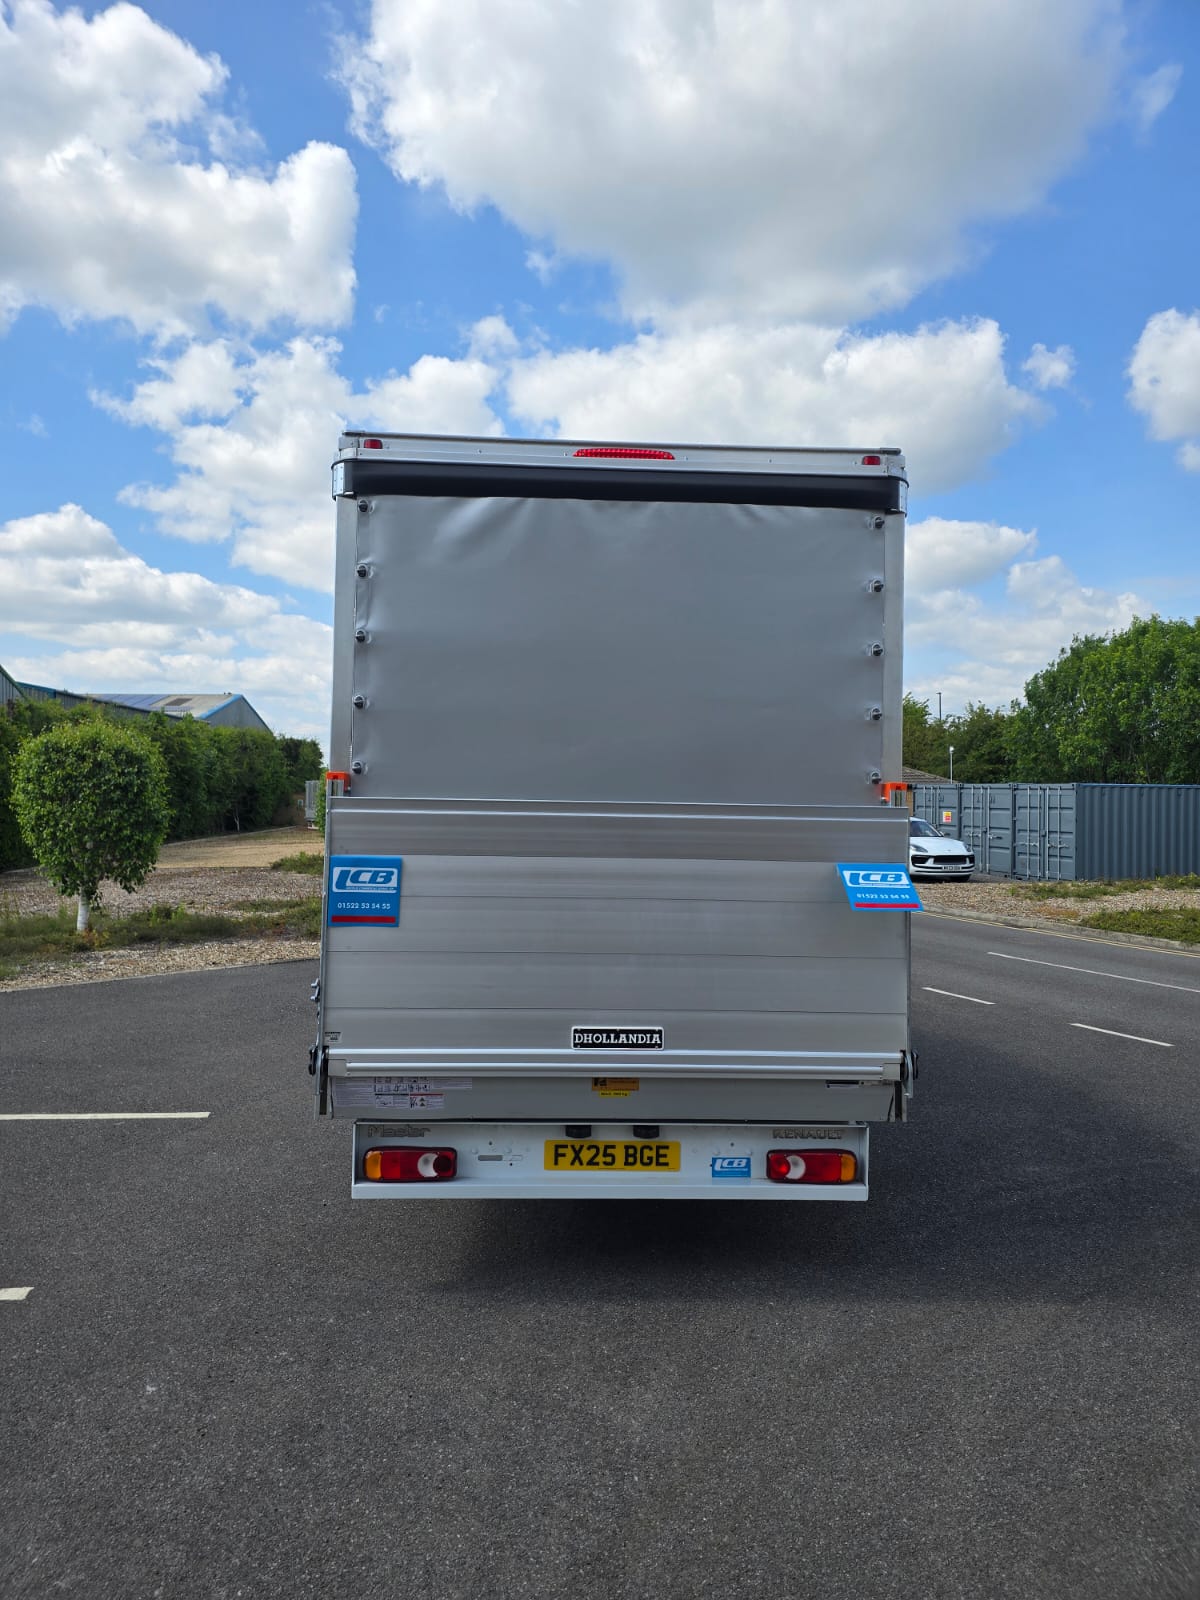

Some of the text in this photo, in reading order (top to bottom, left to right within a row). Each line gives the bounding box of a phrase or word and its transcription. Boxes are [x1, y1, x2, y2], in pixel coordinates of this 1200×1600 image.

[574, 1033, 661, 1044] DHOLLANDIA
[368, 1124, 431, 1138] Master
[773, 1128, 842, 1140] RENAULT
[553, 1144, 670, 1167] FX25 BGE
